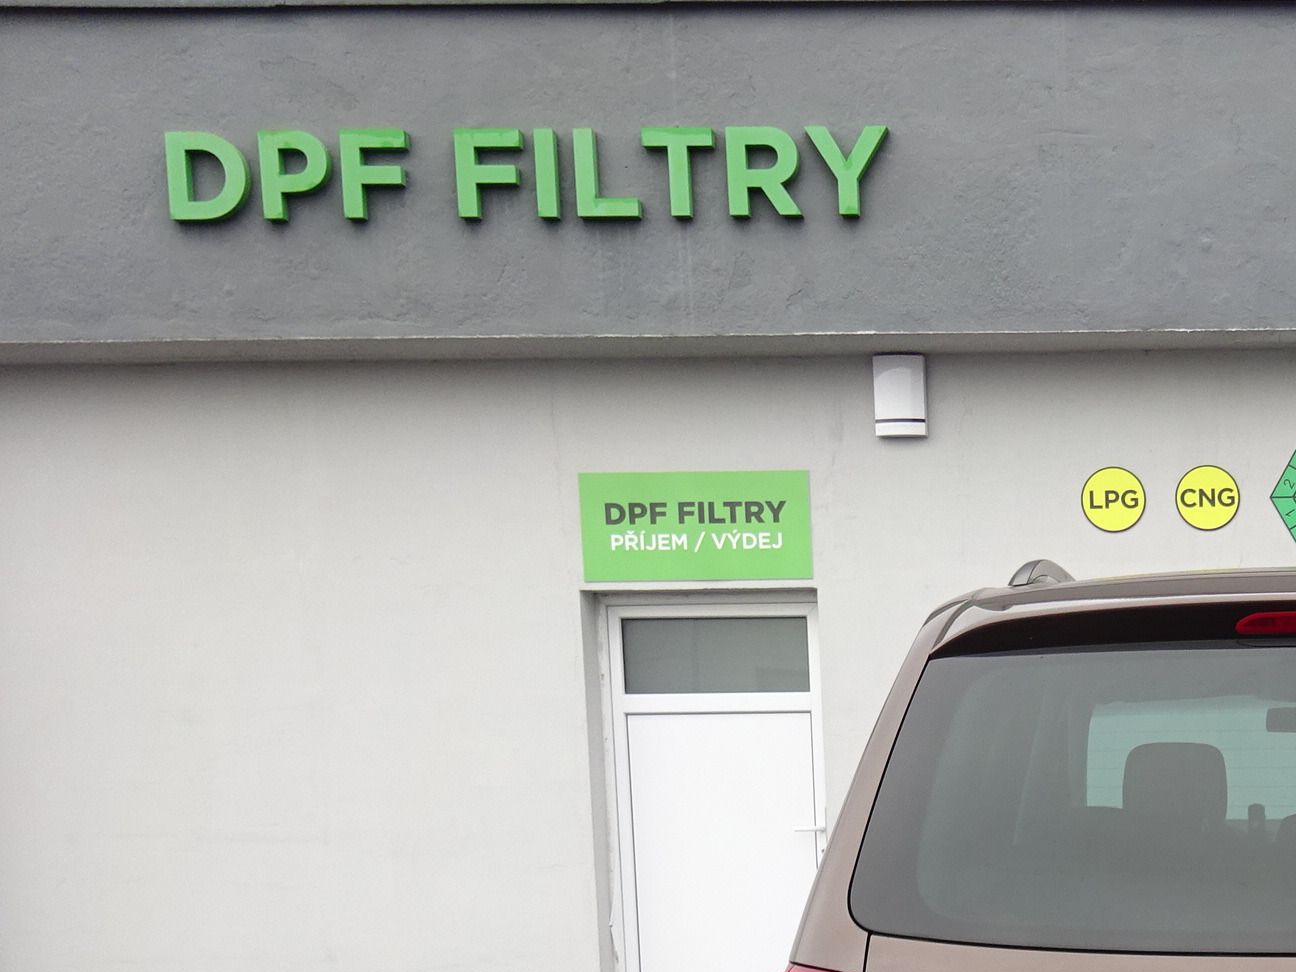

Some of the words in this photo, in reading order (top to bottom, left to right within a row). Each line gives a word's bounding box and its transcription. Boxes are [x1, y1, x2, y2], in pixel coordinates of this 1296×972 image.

[163, 128, 409, 222] DPF
[453, 124, 889, 220] FILTRY
[1284, 478, 1295, 489] 2
[1089, 489, 1139, 509] LPG
[1179, 487, 1236, 508] CNG
[604, 502, 667, 525] DPF
[678, 500, 786, 524] FILTRY
[610, 529, 688, 551] PŘÍJEM
[711, 529, 783, 551] VÝDEJ
